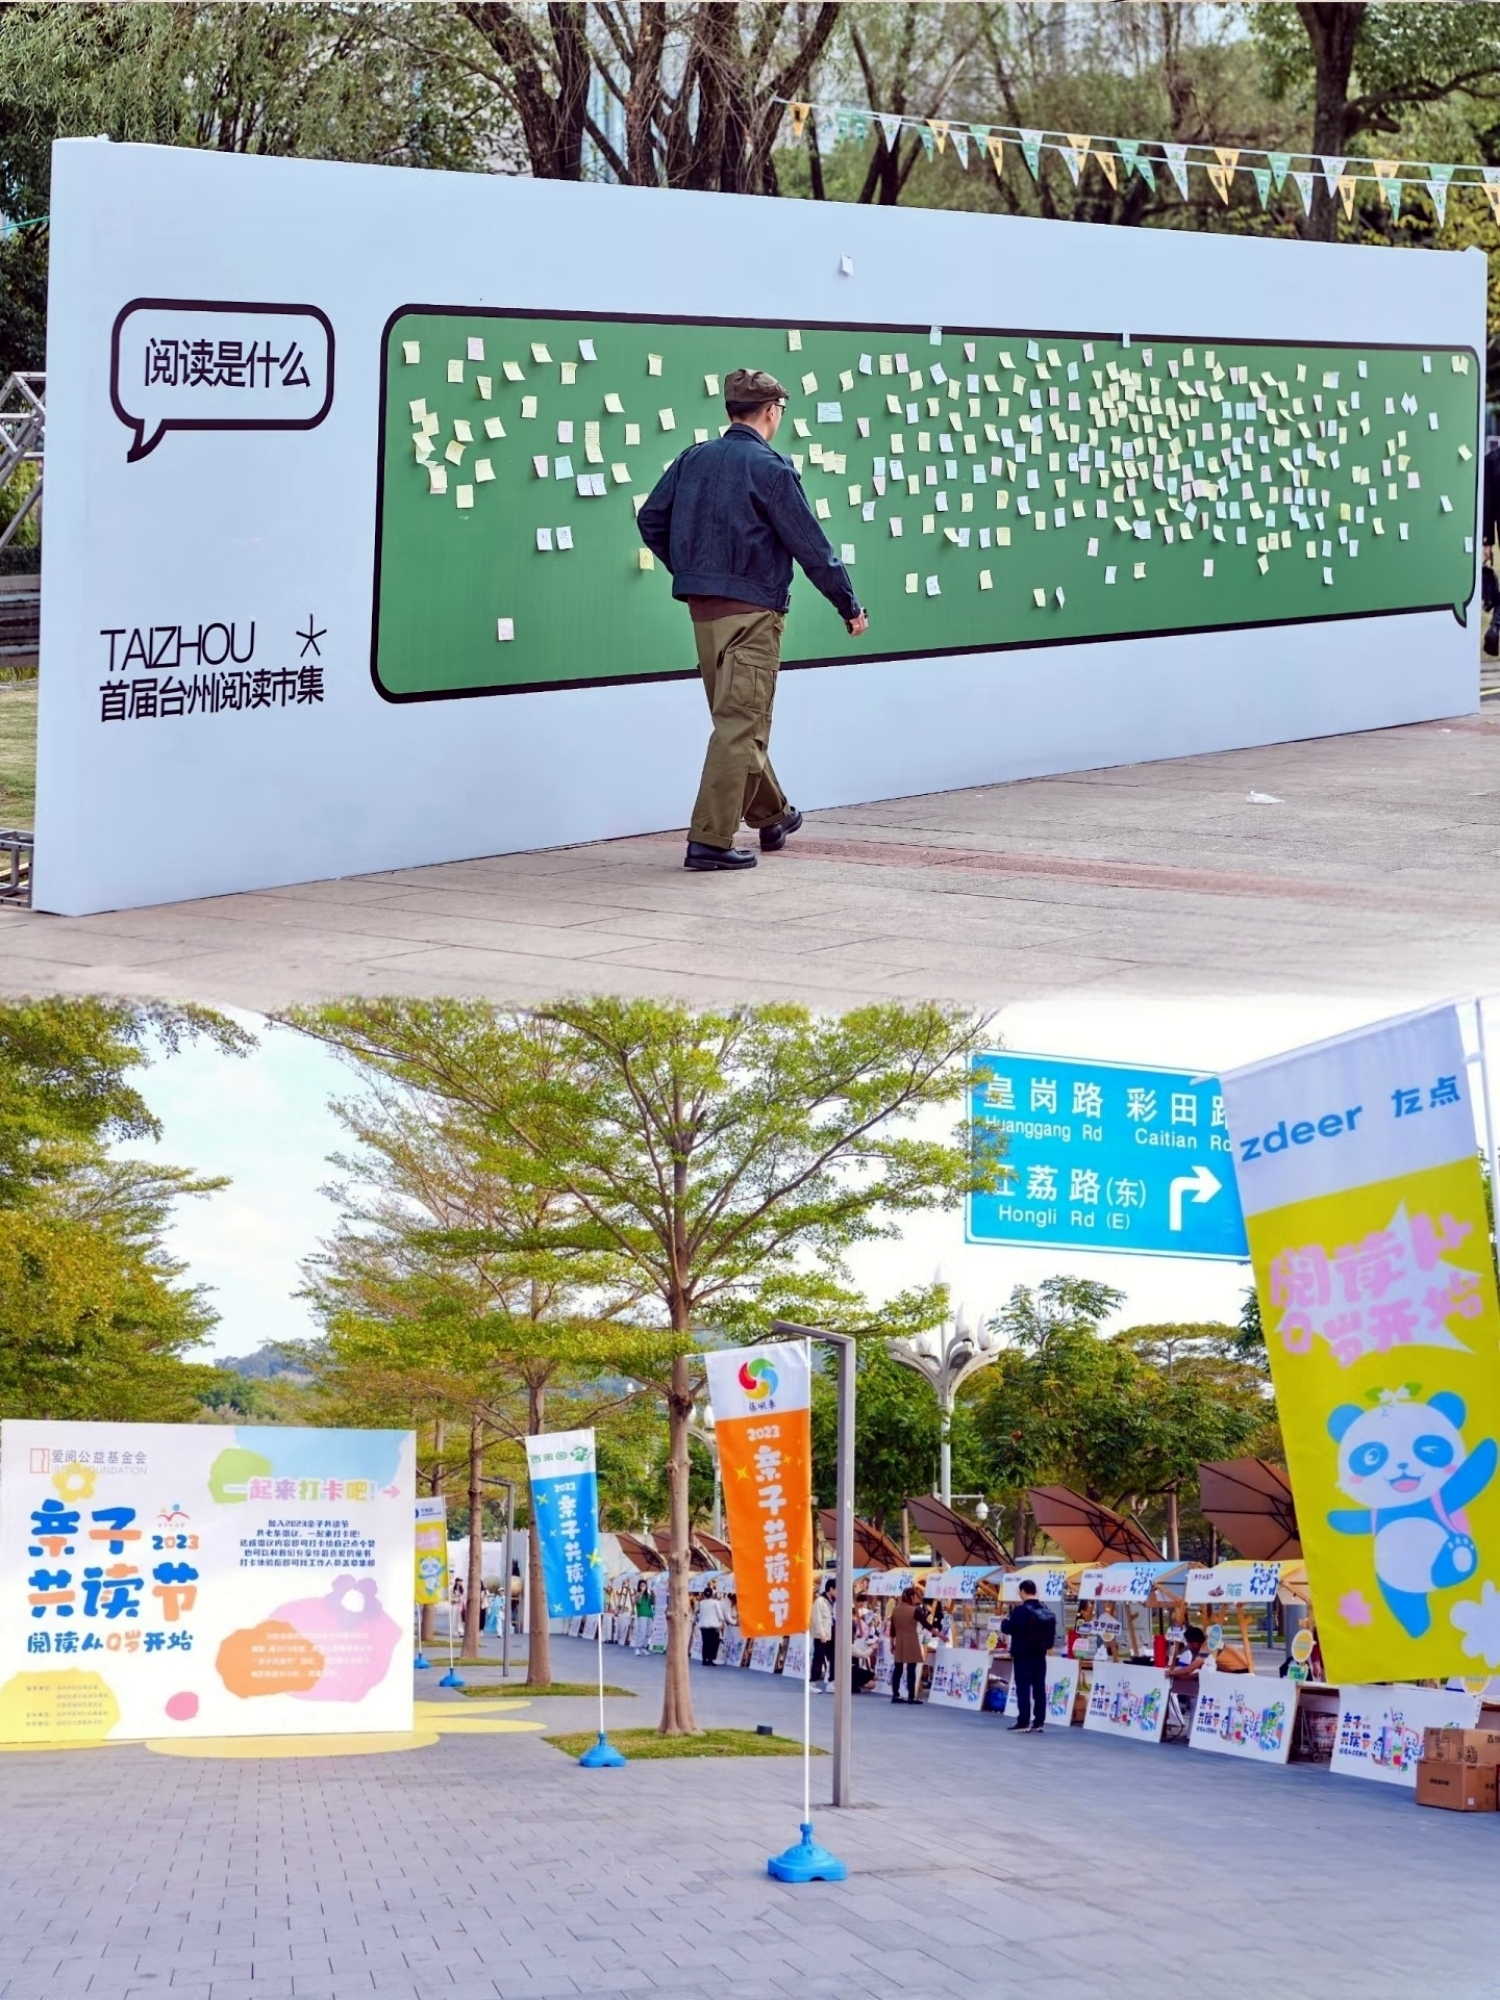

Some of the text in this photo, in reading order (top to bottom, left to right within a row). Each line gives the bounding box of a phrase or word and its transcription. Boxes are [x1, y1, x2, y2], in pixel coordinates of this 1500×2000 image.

[144, 338, 311, 388] 阅读是什么
[100, 621, 255, 672] TAIZHOU
[99, 665, 324, 723] 首届台州阅读市集
[983, 1072, 1103, 1119] 皇岗路
[1391, 1075, 1461, 1118] 左点
[985, 1114, 1102, 1142] Huanggang Rd
[1135, 1128, 1197, 1149] Caitian
[1240, 1104, 1364, 1162] zdeer
[999, 1204, 1130, 1230] Hongli Rd (E)
[746, 1425, 780, 1441] 2023
[51, 1449, 147, 1465] 爱阅公益基金会
[28, 1499, 142, 1557] 亲子
[152, 1534, 200, 1550] 2023
[753, 1445, 790, 1628] 亲子共读节
[27, 1562, 200, 1622] 共读节
[27, 1629, 194, 1653] 阅读从0岁开始
